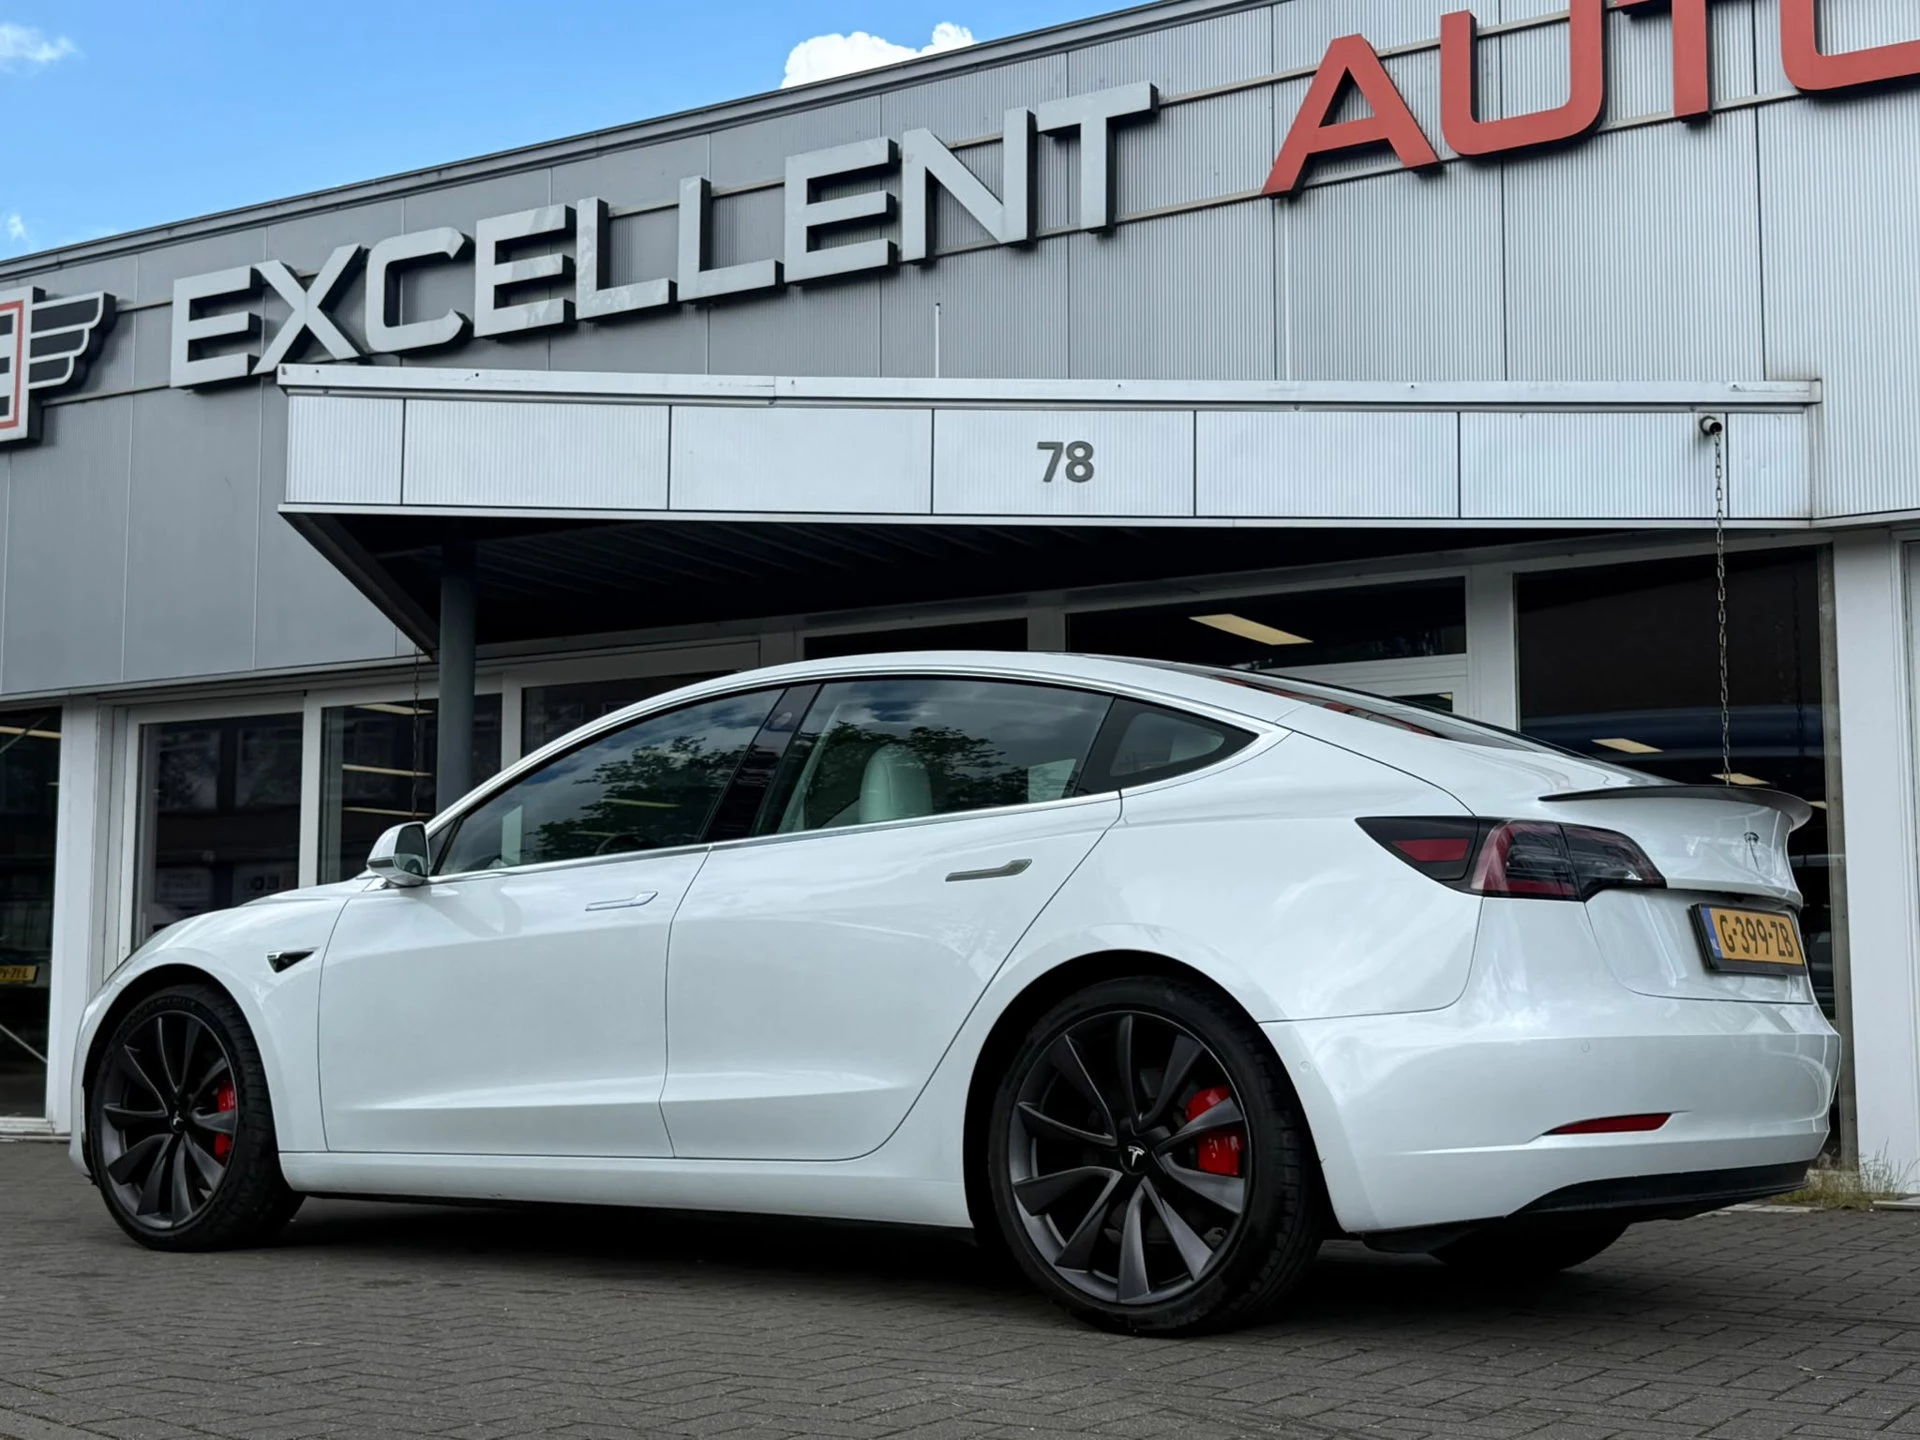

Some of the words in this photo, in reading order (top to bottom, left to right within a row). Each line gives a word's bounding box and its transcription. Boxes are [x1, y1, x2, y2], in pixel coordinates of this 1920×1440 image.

[170, 81, 1157, 389] EXCELLENT
[1037, 441, 1094, 482] 78
[1719, 914, 1794, 957] G-399-ZB
